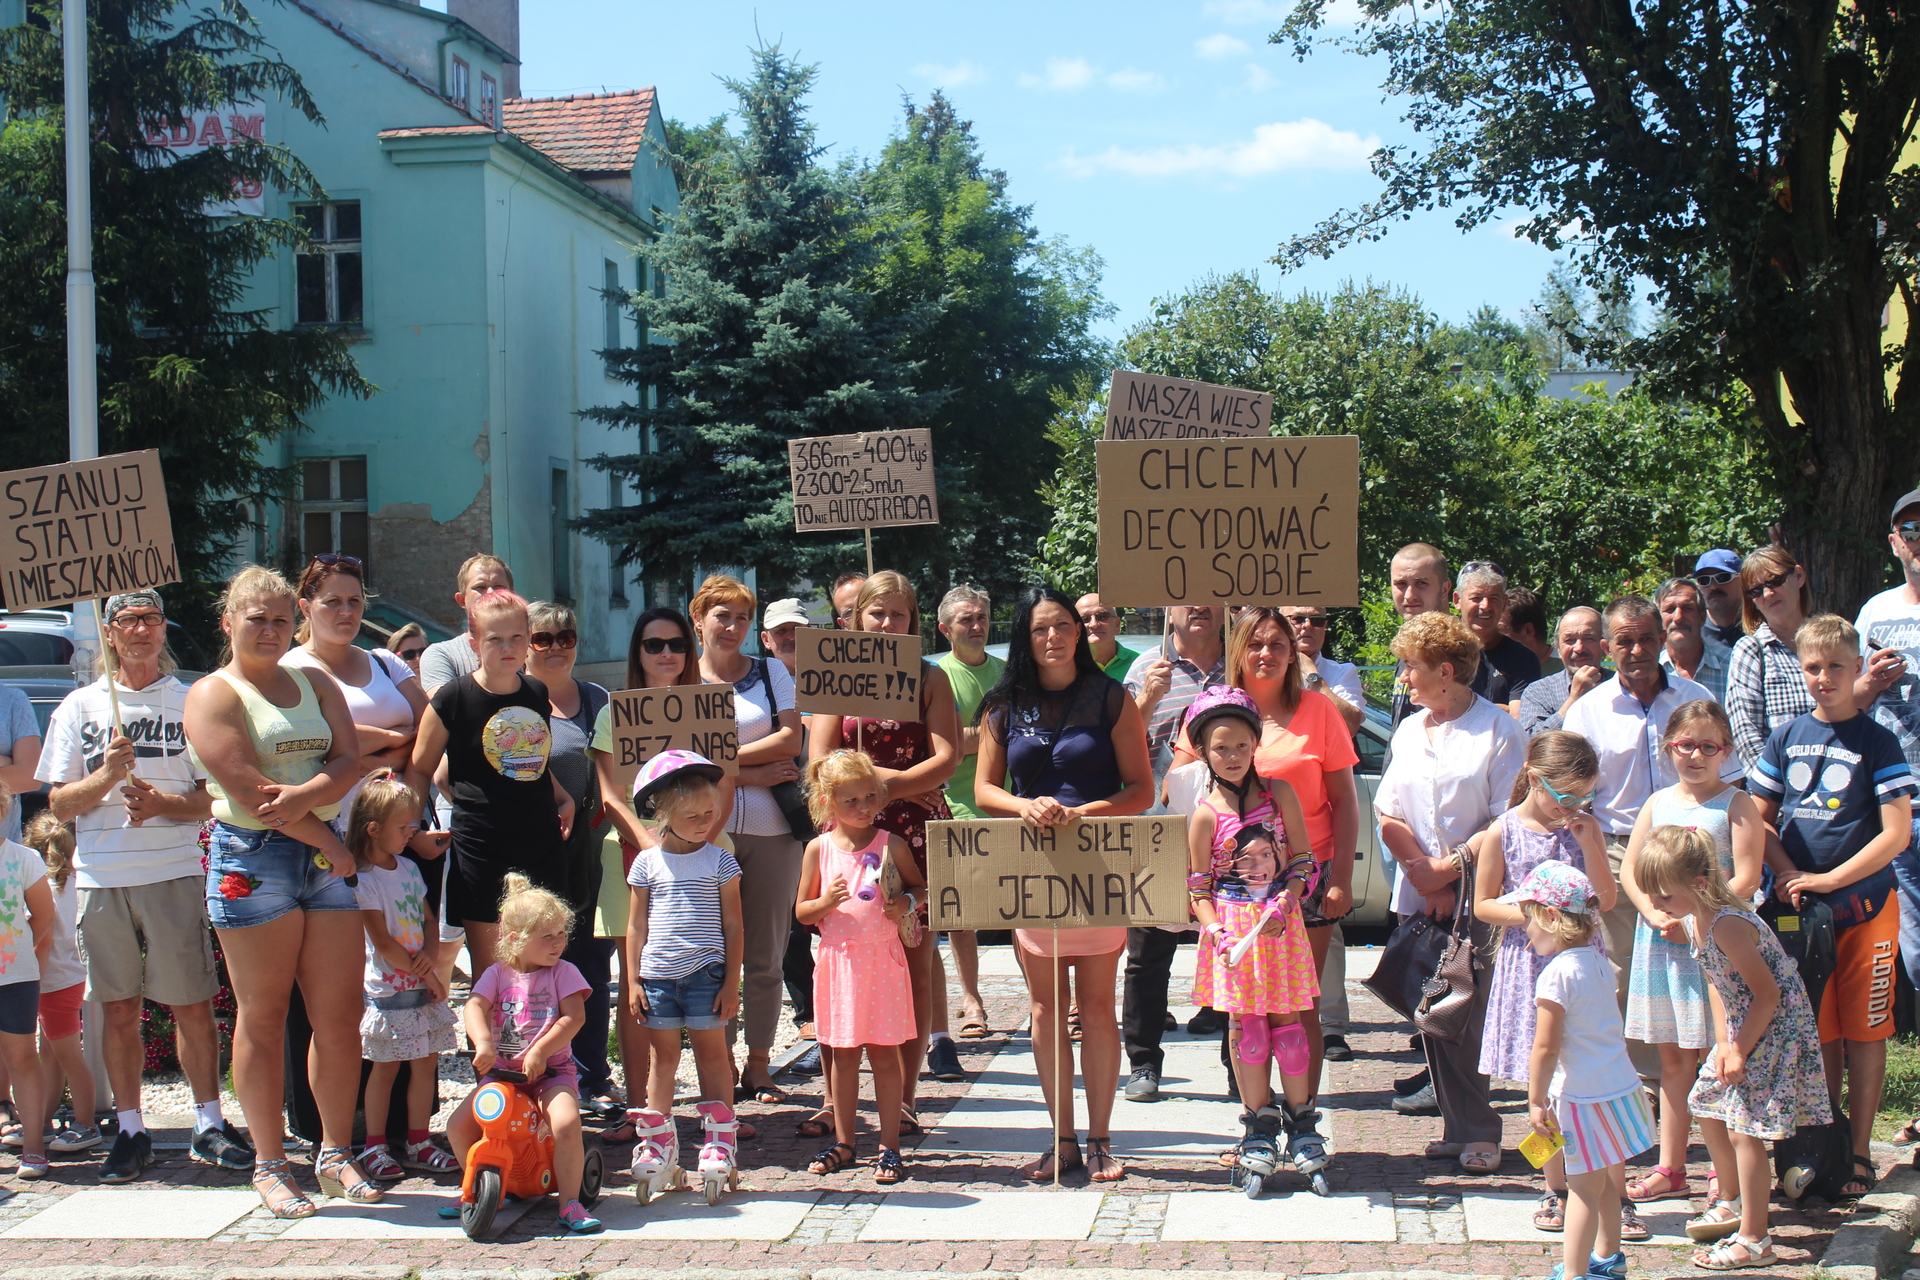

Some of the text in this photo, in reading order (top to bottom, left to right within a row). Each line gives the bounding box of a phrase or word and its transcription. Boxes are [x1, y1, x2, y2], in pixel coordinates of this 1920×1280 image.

[1128, 380, 1262, 429] NASZA WIEŚ
[1139, 445, 1308, 490] CHCEMY
[5, 464, 144, 520] SZANUJ
[829, 494, 933, 524] AUTOSTRADA
[15, 505, 147, 562] STATUT
[1124, 493, 1331, 550] DECYDOWAĆ
[8, 539, 177, 606] I MIESZKAŃCÓW
[1165, 552, 1322, 600] O SOBIE
[817, 637, 898, 667] CHCEMY
[800, 669, 880, 700] DROGĘ
[612, 690, 735, 728] NIC O NAS
[691, 731, 738, 761] NAS
[1786, 744, 1810, 759] WORLD
[947, 827, 991, 858] NIC
[1020, 825, 1056, 852] NA
[1077, 823, 1134, 857] SIŁĘ
[940, 872, 1155, 920] A JEDNAK
[1867, 940, 1893, 1028] FLORIDA
